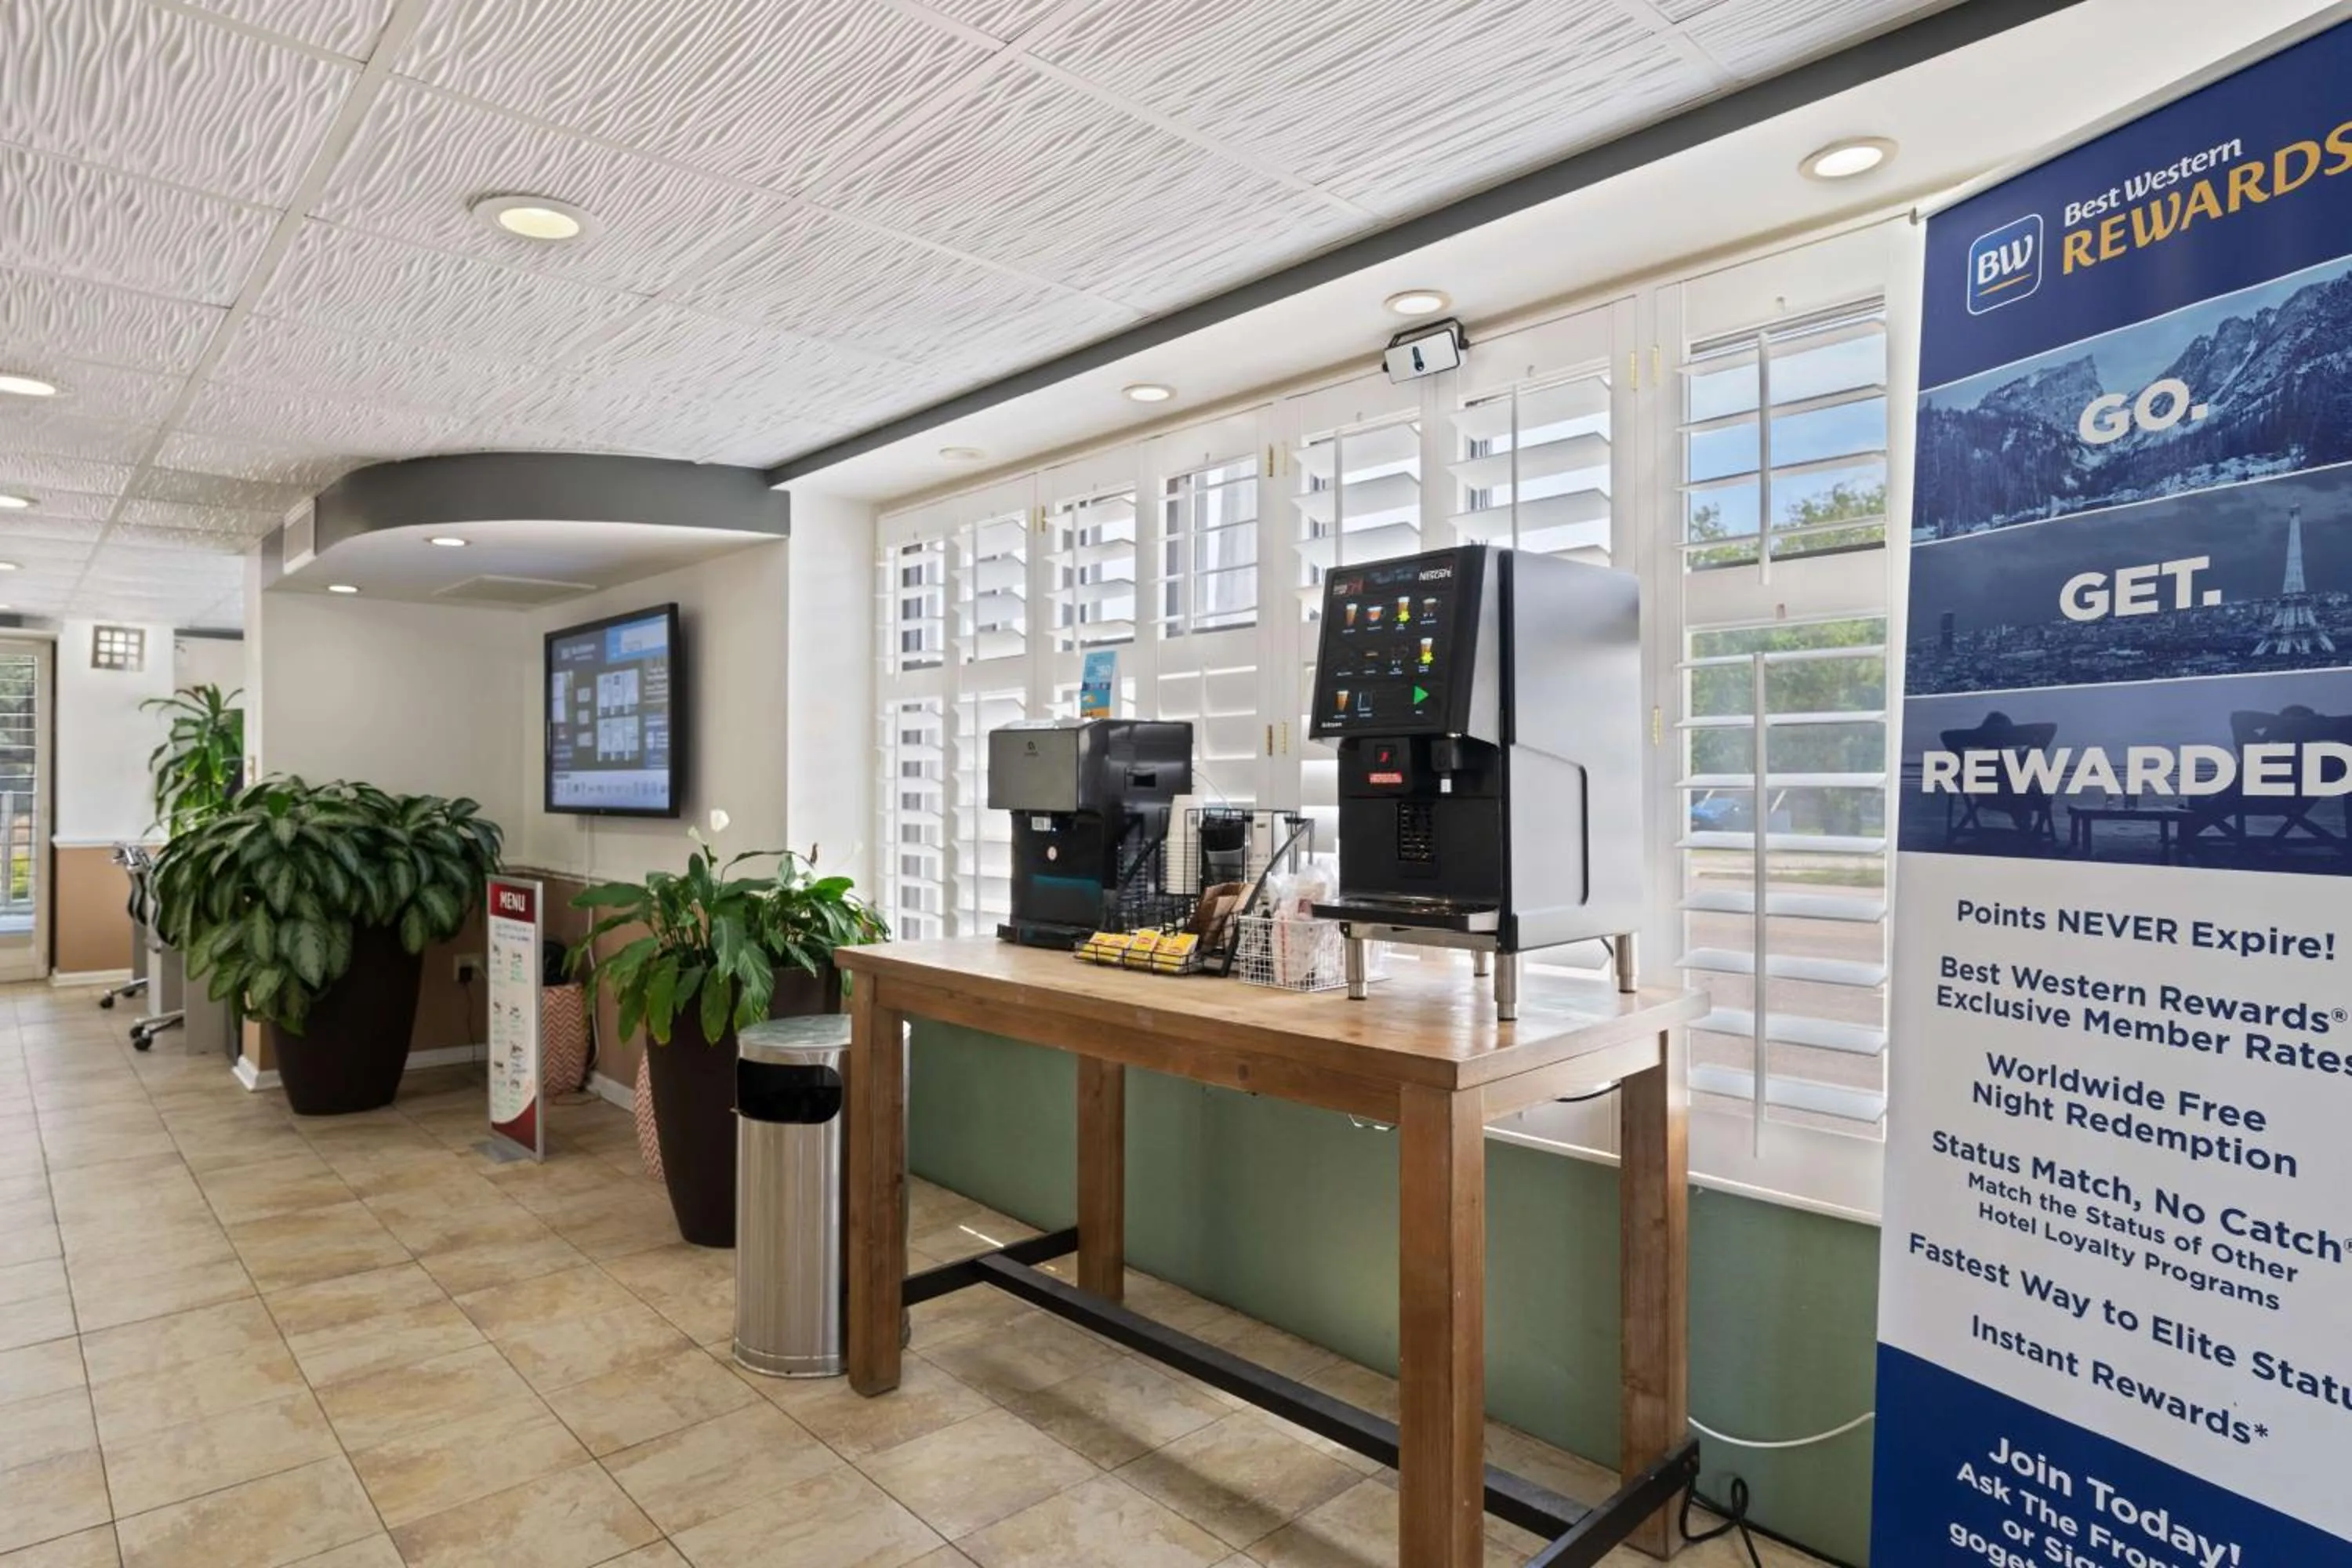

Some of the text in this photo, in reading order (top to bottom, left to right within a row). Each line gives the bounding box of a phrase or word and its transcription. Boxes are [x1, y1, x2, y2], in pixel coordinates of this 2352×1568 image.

[2063, 121, 2352, 274] REWARDS
[2064, 138, 2241, 227] Best Western
[1977, 235, 2033, 285] BW
[2078, 378, 2209, 445] GO.
[2059, 556, 2221, 621] GET.
[1922, 742, 2352, 797] REWARDED
[499, 891, 526, 912] MENU
[1957, 899, 2335, 960] Points NEVER Expire!
[1940, 956, 2001, 985] Best
[2012, 965, 2146, 1007] Western
[1937, 985, 2352, 1076] Exclusive Member Rates
[1973, 1080, 2296, 1178] Night Redemption
[1986, 1051, 2267, 1132] Worldwide Free
[1933, 1130, 2020, 1174] Status
[2031, 1156, 2141, 1212] Match,
[2155, 1188, 2205, 1225] No
[1969, 1171, 2299, 1283] Match the Status of Other
[1979, 1202, 2281, 1311] Hotel Loyalty Programs
[1909, 1232, 2010, 1288] Fastest
[2020, 1270, 2091, 1319] Way
[2103, 1299, 2139, 1332] to
[2152, 1315, 2237, 1368] Elite
[1973, 1314, 2079, 1377] Instant
[1957, 1462, 2180, 1568] Ask The Fro
[1989, 1437, 2241, 1568] Join Today!
[2002, 1519, 2035, 1548] or
